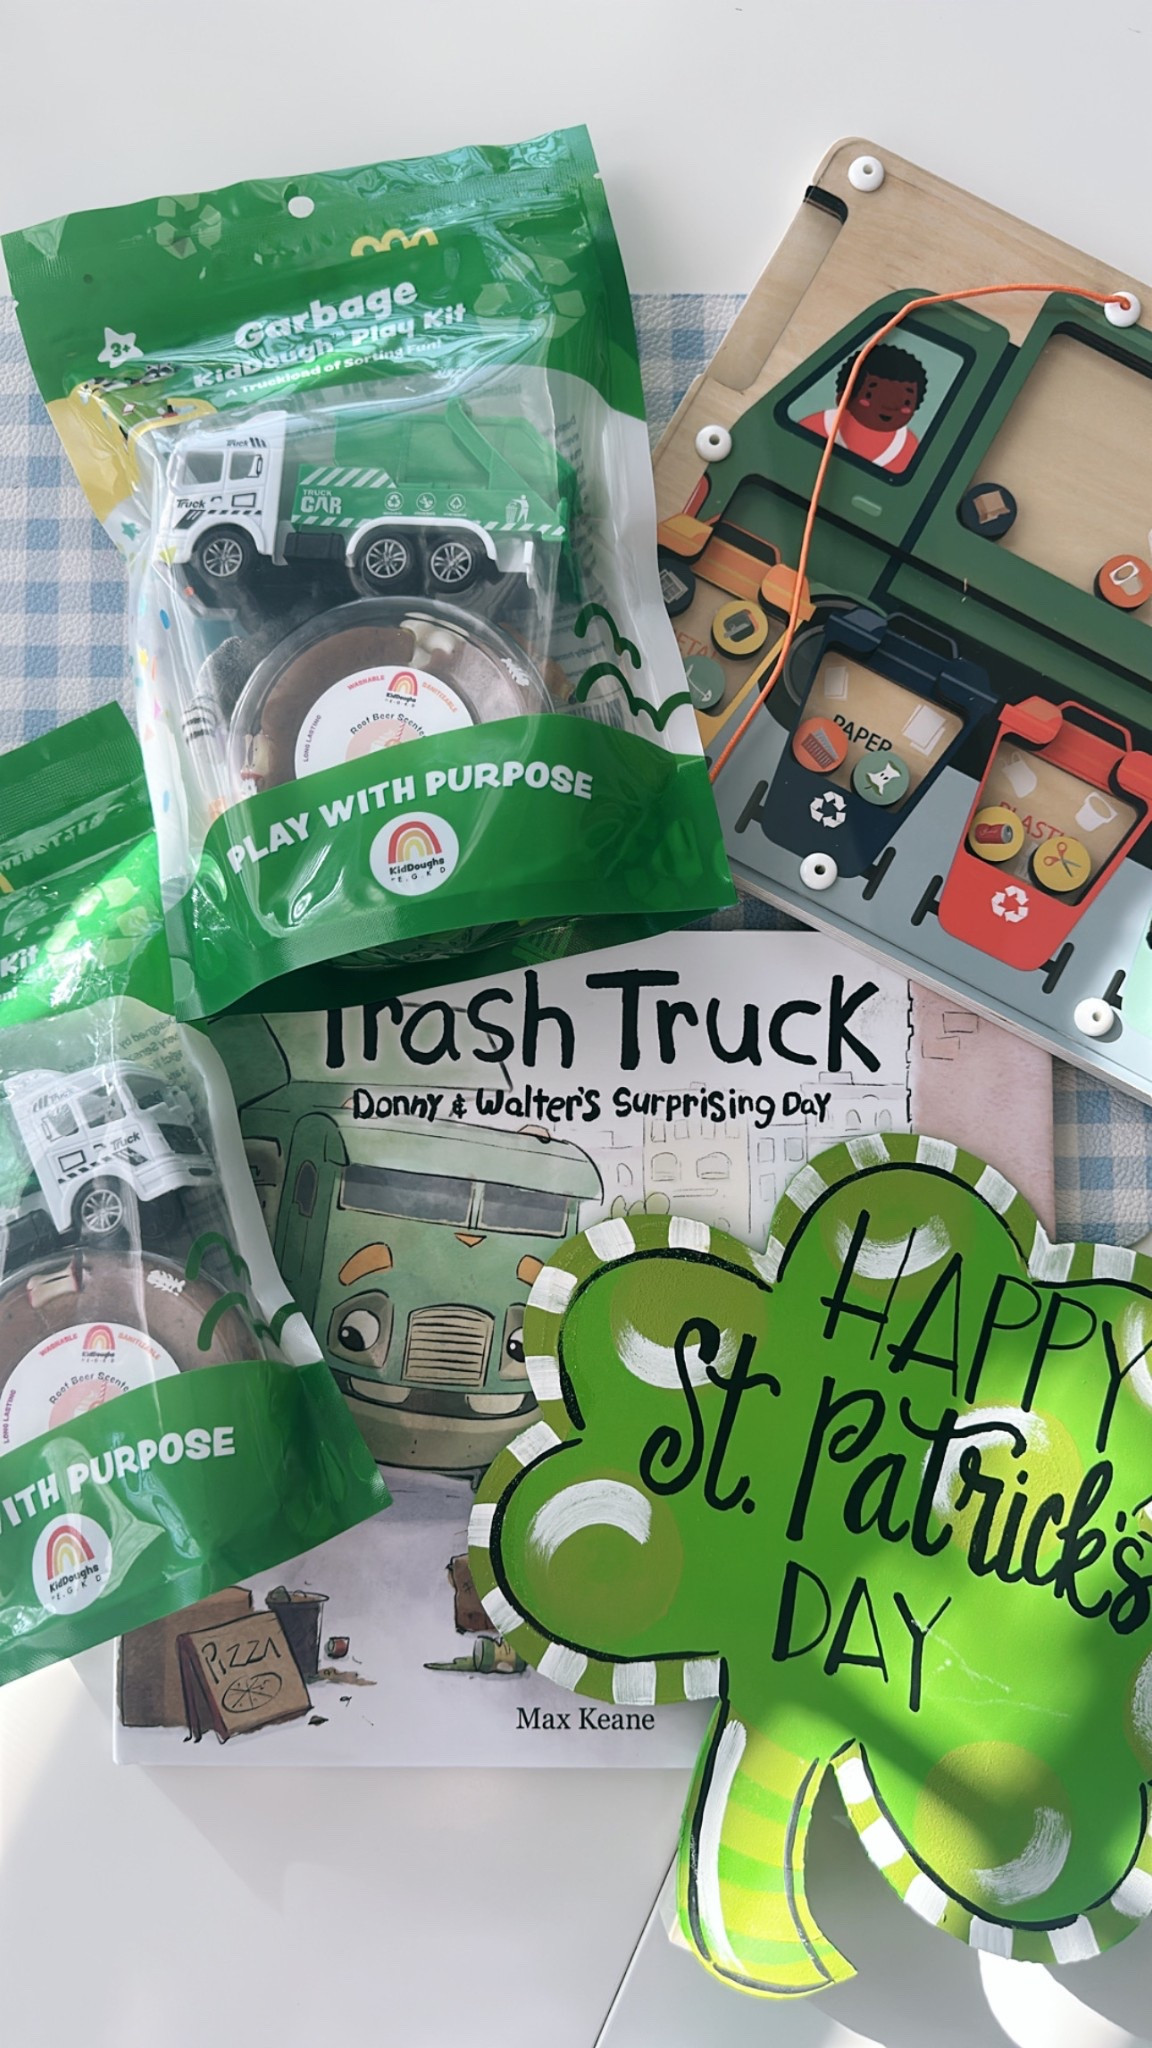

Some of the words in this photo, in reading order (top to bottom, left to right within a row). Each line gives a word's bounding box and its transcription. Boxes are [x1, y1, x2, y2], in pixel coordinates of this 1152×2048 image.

[234, 281, 418, 350] Garbage
[352, 318, 415, 347] Play
[423, 303, 466, 330] Kit
[110, 342, 131, 358] 3+
[226, 388, 238, 398] A
[241, 364, 322, 394] Truckload
[323, 359, 341, 373] of
[343, 346, 404, 369] Sorting
[405, 338, 442, 355] Fun!
[176, 498, 206, 509] Truck
[300, 496, 342, 515] CAR
[303, 489, 332, 497] TRUCK
[347, 674, 385, 691] WASHABLE
[306, 714, 322, 742] LASTING
[350, 716, 371, 736] Root
[372, 712, 395, 722] Beer
[397, 712, 427, 738] Scente
[226, 811, 310, 875] PLAY
[318, 775, 416, 829] WITH
[424, 760, 594, 801] PURPOSE
[389, 857, 445, 876] KidDoughs
[0, 944, 39, 978] Kit
[586, 968, 881, 1073] Truck
[352, 1088, 444, 1121] Donny
[450, 1092, 468, 1121] &
[475, 1084, 601, 1122] Walter's
[614, 1089, 776, 1128] Surprising
[110, 1131, 141, 1150] Truck
[820, 1209, 1152, 1453] HAPPY
[3, 1388, 17, 1422] LASTING
[49, 1382, 69, 1405] Root
[70, 1373, 94, 1385] Beer
[97, 1371, 130, 1393] Scente
[2, 1423, 10, 1445] LONG
[0, 1473, 60, 1535] ITH
[67, 1426, 236, 1495] PURPOSE
[639, 1316, 781, 1515] St.
[786, 1376, 1152, 1635] Patrick's
[49, 1563, 100, 1593] KidDoughs
[772, 1559, 952, 1713] DAY
[516, 1706, 571, 1731] Max
[578, 1706, 656, 1731] Keane
